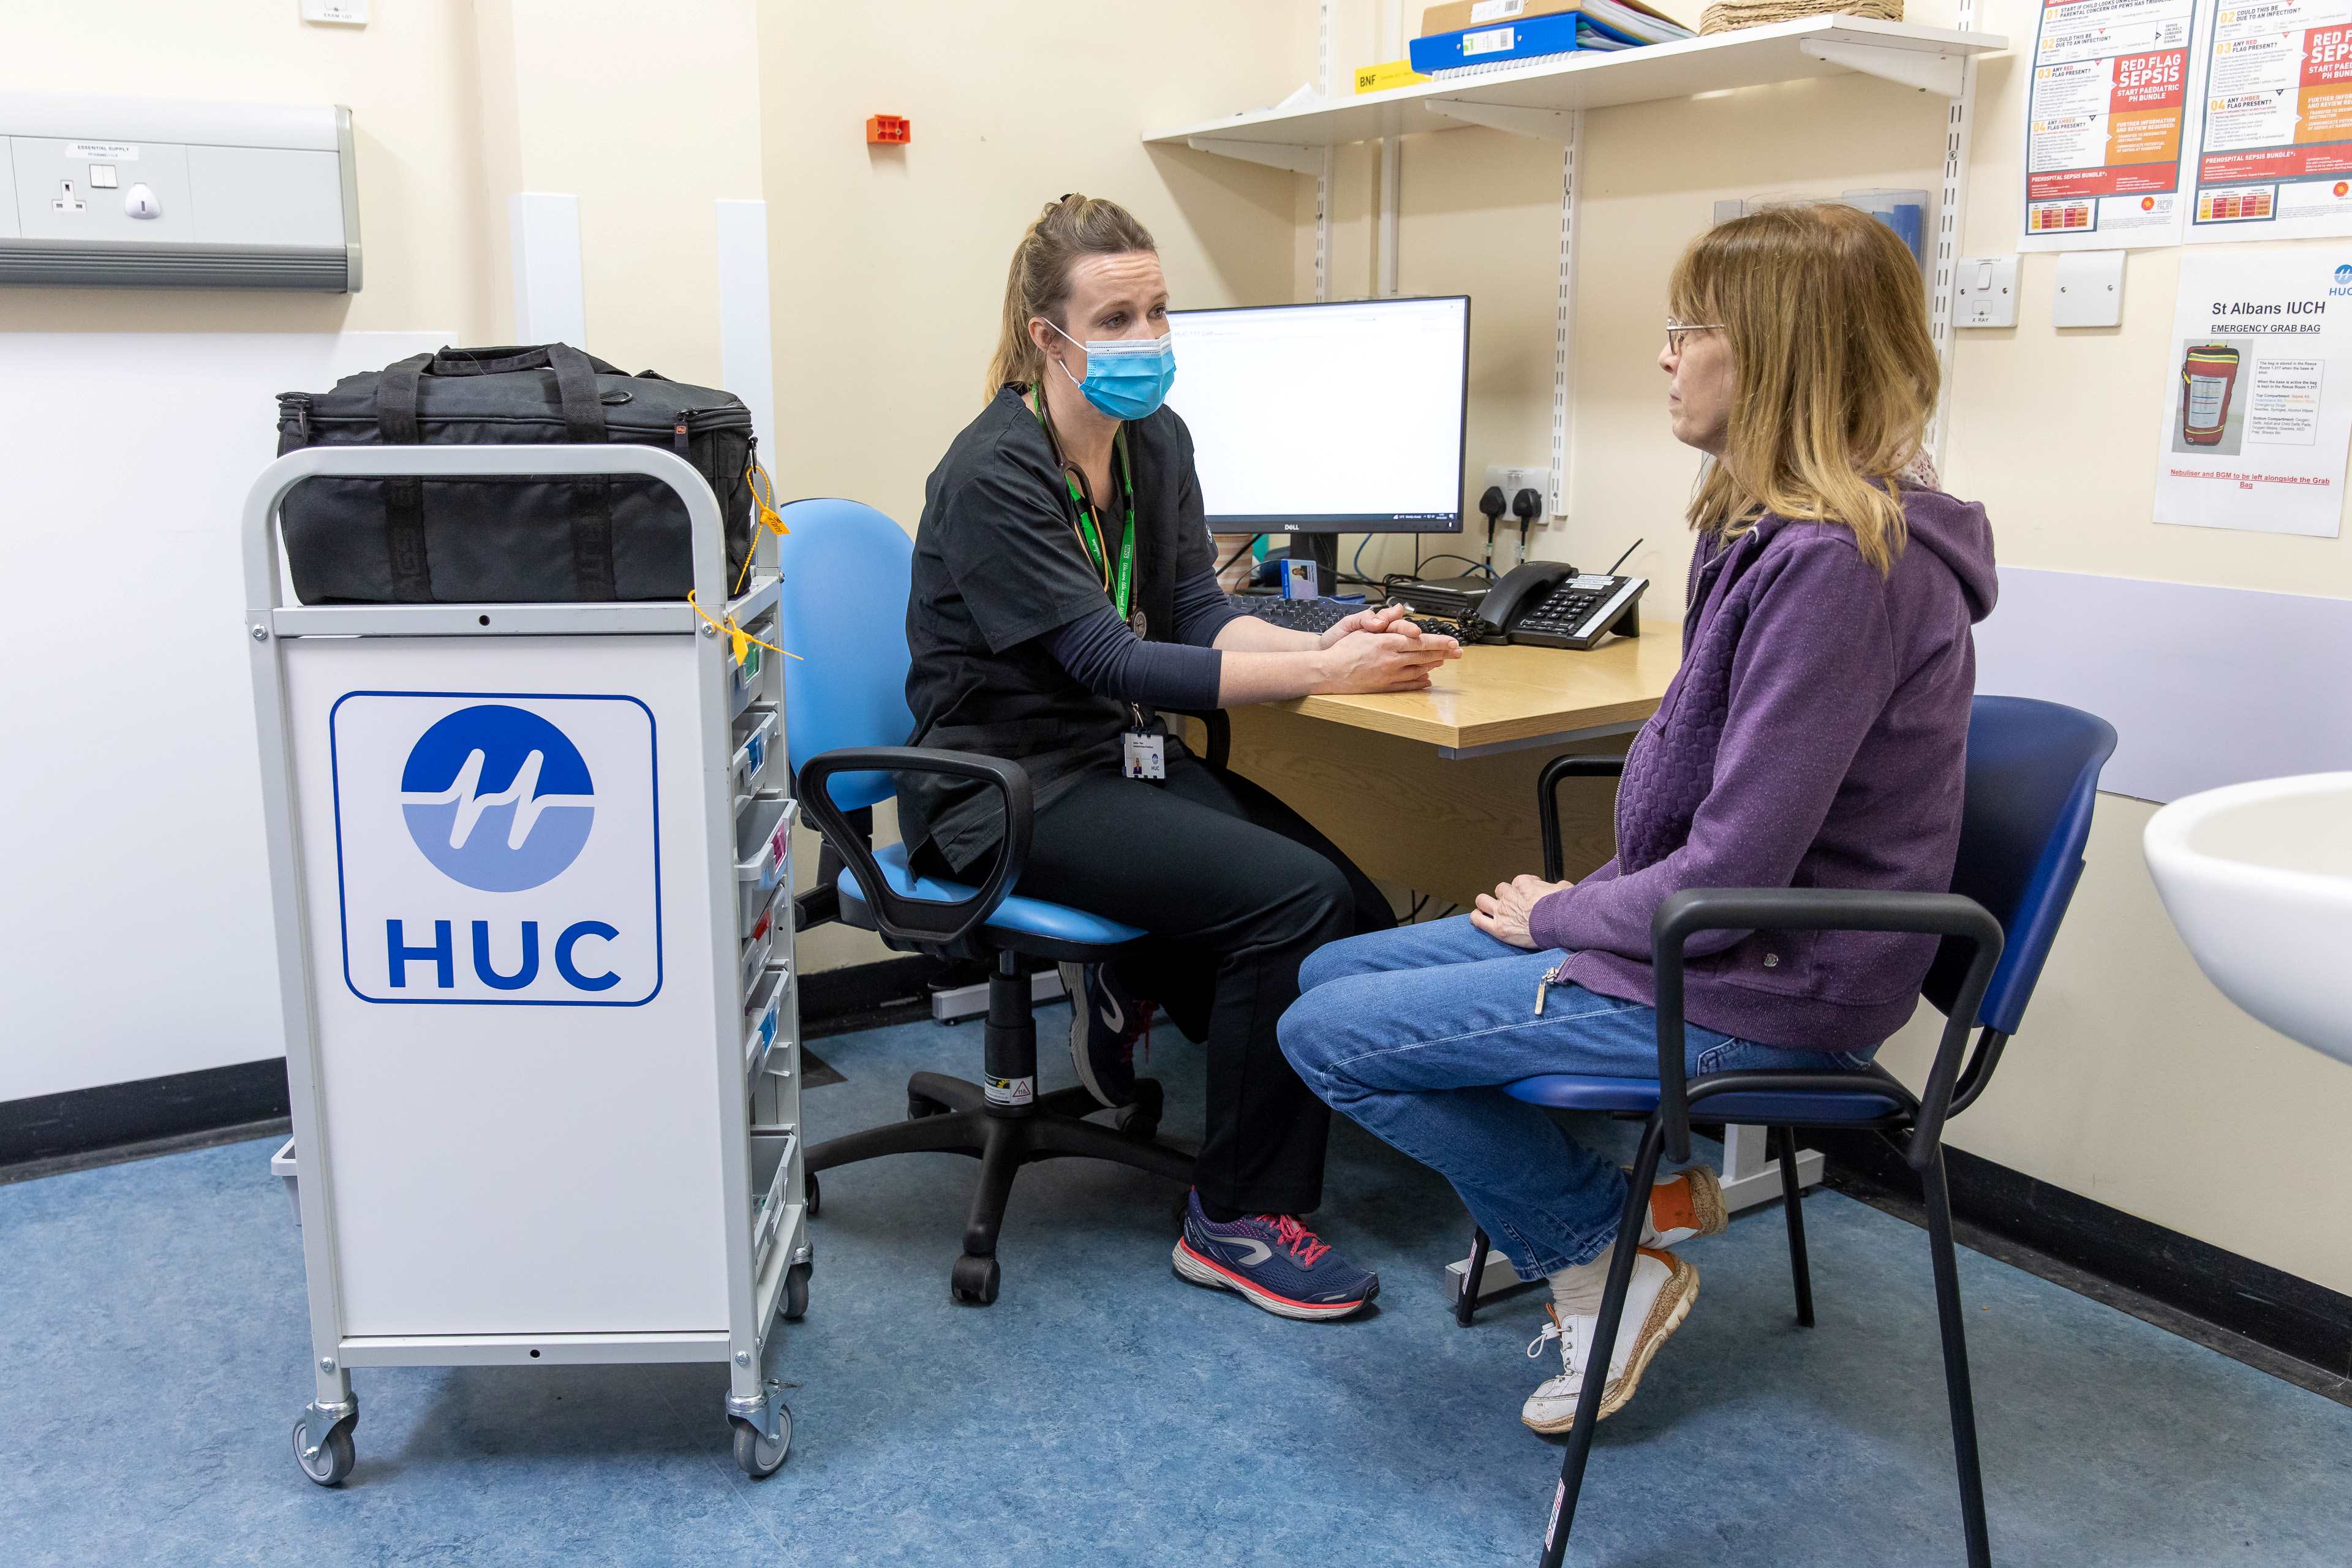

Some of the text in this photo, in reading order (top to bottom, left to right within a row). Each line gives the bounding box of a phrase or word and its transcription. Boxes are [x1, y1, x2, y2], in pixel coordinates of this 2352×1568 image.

[2046, 9, 2058, 20] 01
[2220, 12, 2235, 24] 02
[2266, 8, 2301, 17] INFECTION?
[2042, 39, 2055, 50] 02
[2313, 31, 2342, 47] RED
[2216, 43, 2231, 55] 03
[2248, 42, 2277, 51] PRESENT?
[2120, 54, 2181, 72] RED FLAG
[2038, 68, 2051, 79] 03
[2309, 64, 2333, 74] START
[1360, 74, 1376, 88] BNF
[2119, 66, 2179, 88] SEPSIS
[2117, 84, 2180, 97] START PAEDIATRIC
[2139, 92, 2166, 101] BUNDLE
[2211, 99, 2225, 111] 04
[2243, 99, 2272, 108] PRESENT?
[2141, 117, 2176, 126] INFORMATION
[2034, 122, 2046, 133] 04
[2032, 174, 2062, 183] PREHOSPITAL
[2212, 301, 2325, 315] St Albans IUCH
[2211, 325, 2321, 333] EMERGENCY GRAB BAG
[2171, 469, 2200, 478] Nebuliser
[2264, 475, 2298, 484] alongside
[2239, 481, 2253, 489] Bag
[386, 919, 622, 992] HUC
